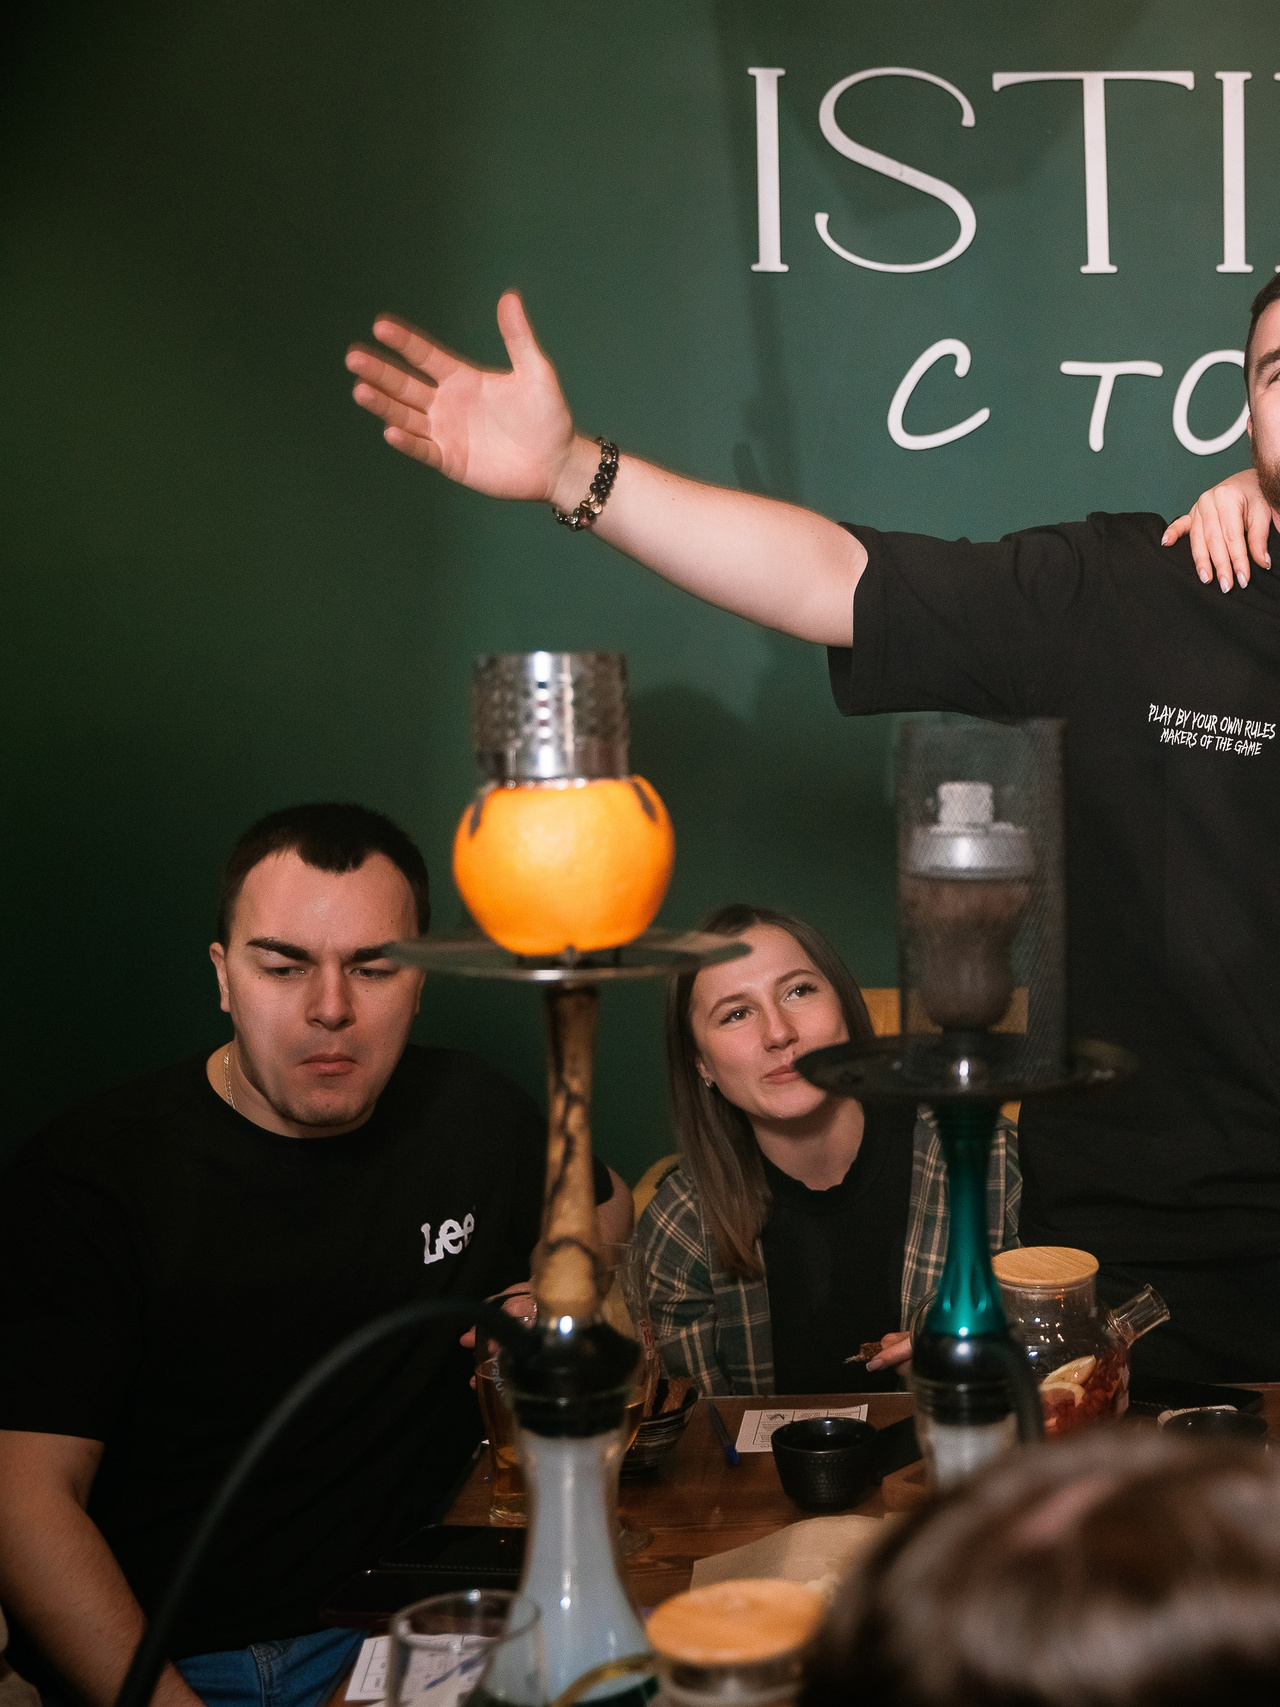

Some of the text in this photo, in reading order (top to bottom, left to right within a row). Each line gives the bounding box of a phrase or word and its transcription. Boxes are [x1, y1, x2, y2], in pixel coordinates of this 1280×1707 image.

[1148, 703, 1276, 739] PLAY BY YOUR OWN RULES
[1160, 728, 1263, 756] MAKERS OF THE GAME
